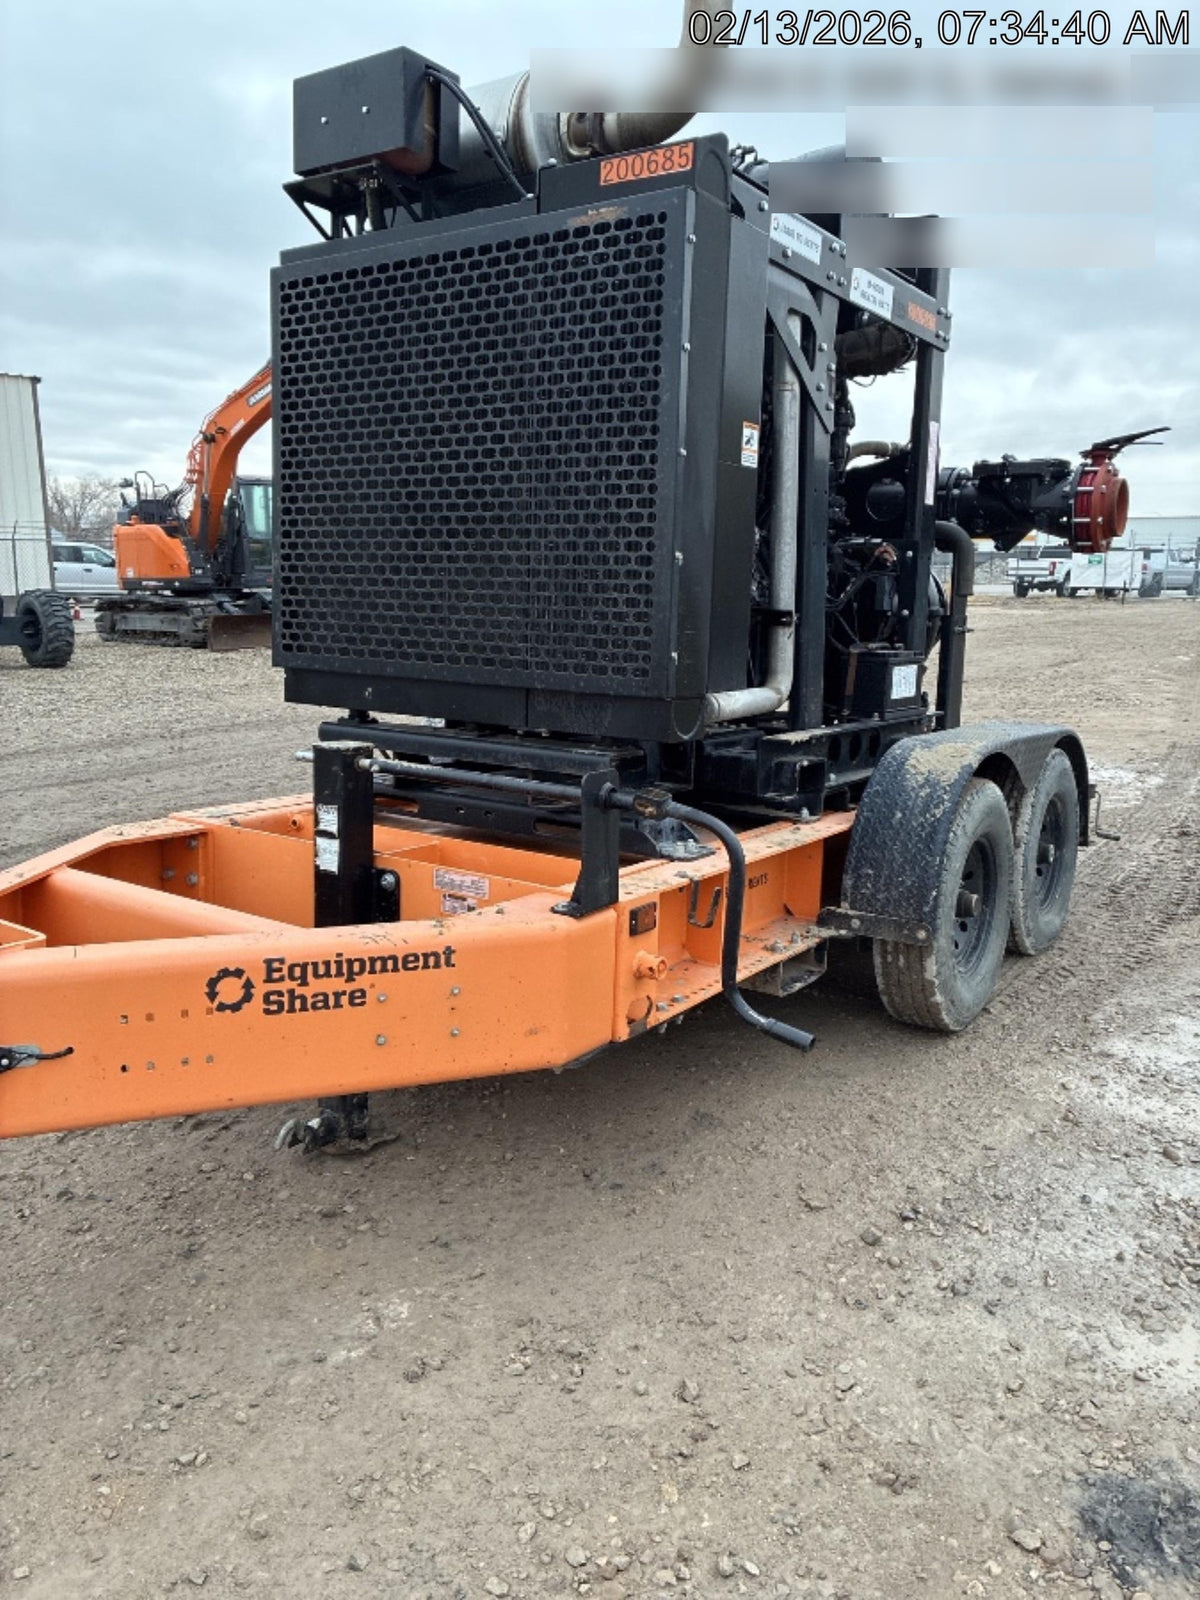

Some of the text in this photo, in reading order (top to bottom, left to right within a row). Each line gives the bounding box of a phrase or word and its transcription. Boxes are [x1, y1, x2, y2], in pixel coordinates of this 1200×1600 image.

[602, 145, 690, 183] 200685
[262, 945, 456, 987] Equipment
[262, 987, 367, 1016] Share
